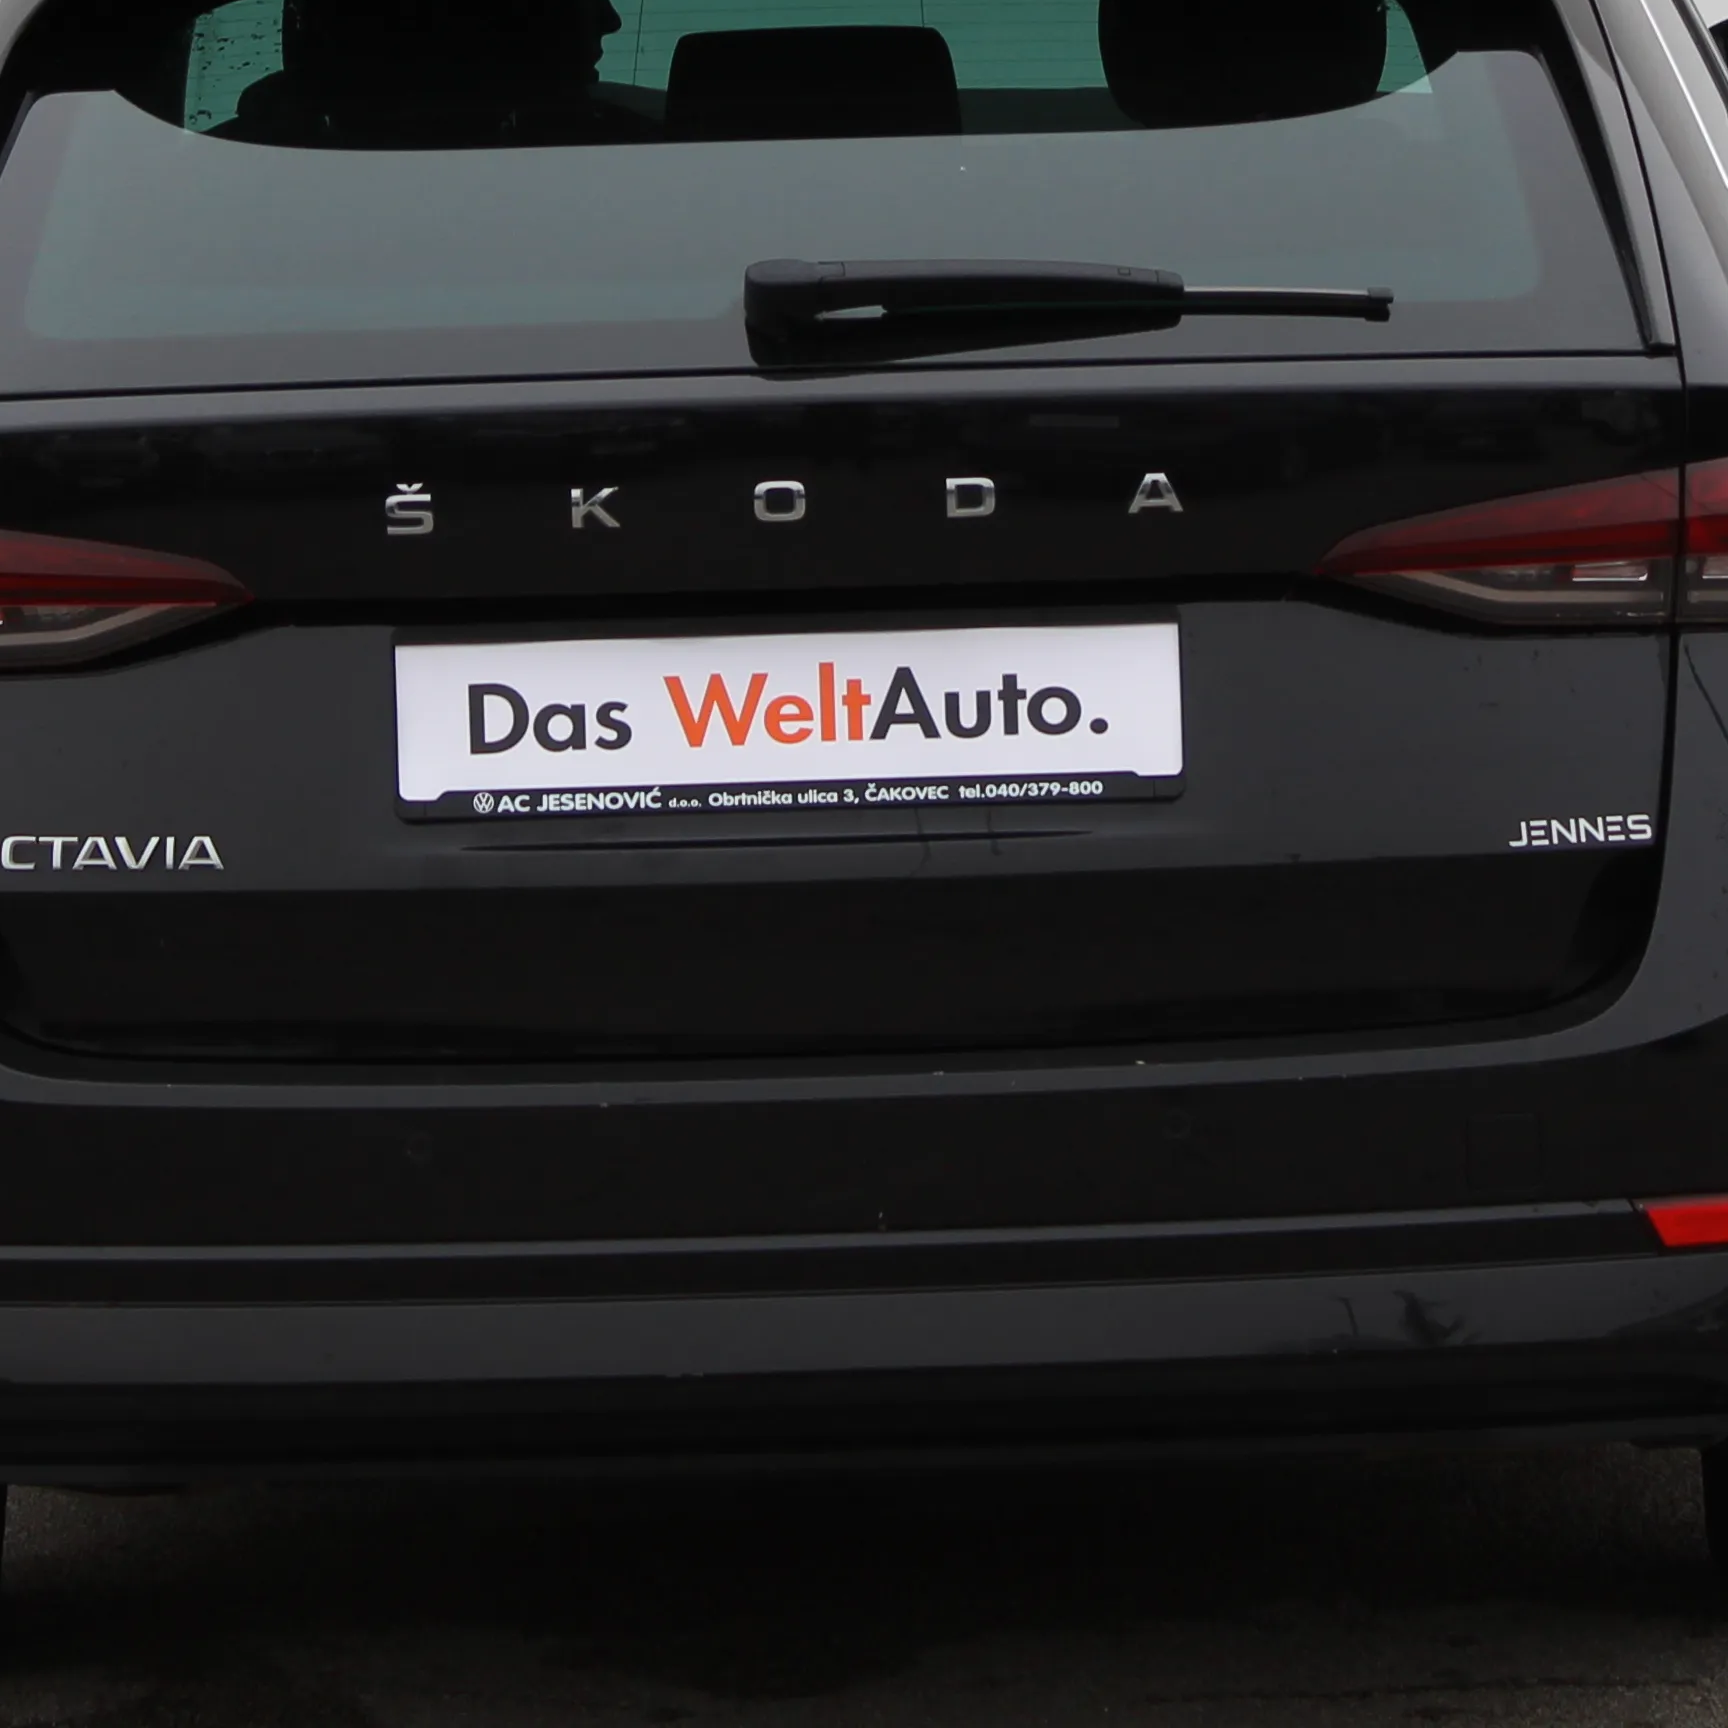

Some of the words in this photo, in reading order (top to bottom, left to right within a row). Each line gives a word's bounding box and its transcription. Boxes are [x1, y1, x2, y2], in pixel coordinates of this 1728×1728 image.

[385, 472, 1184, 536] ŠKODA
[468, 683, 633, 756] Das
[664, 662, 1110, 749] WeltAuto.
[497, 794, 531, 813] AC
[536, 787, 662, 812] JESENOVIĆ
[668, 797, 702, 809] d.o.o.
[708, 789, 793, 807] Obrtnička
[797, 788, 839, 804] ulica
[843, 788, 860, 804] 3,
[864, 783, 950, 802] ČAKOVEC
[1509, 814, 1653, 848] JENNES
